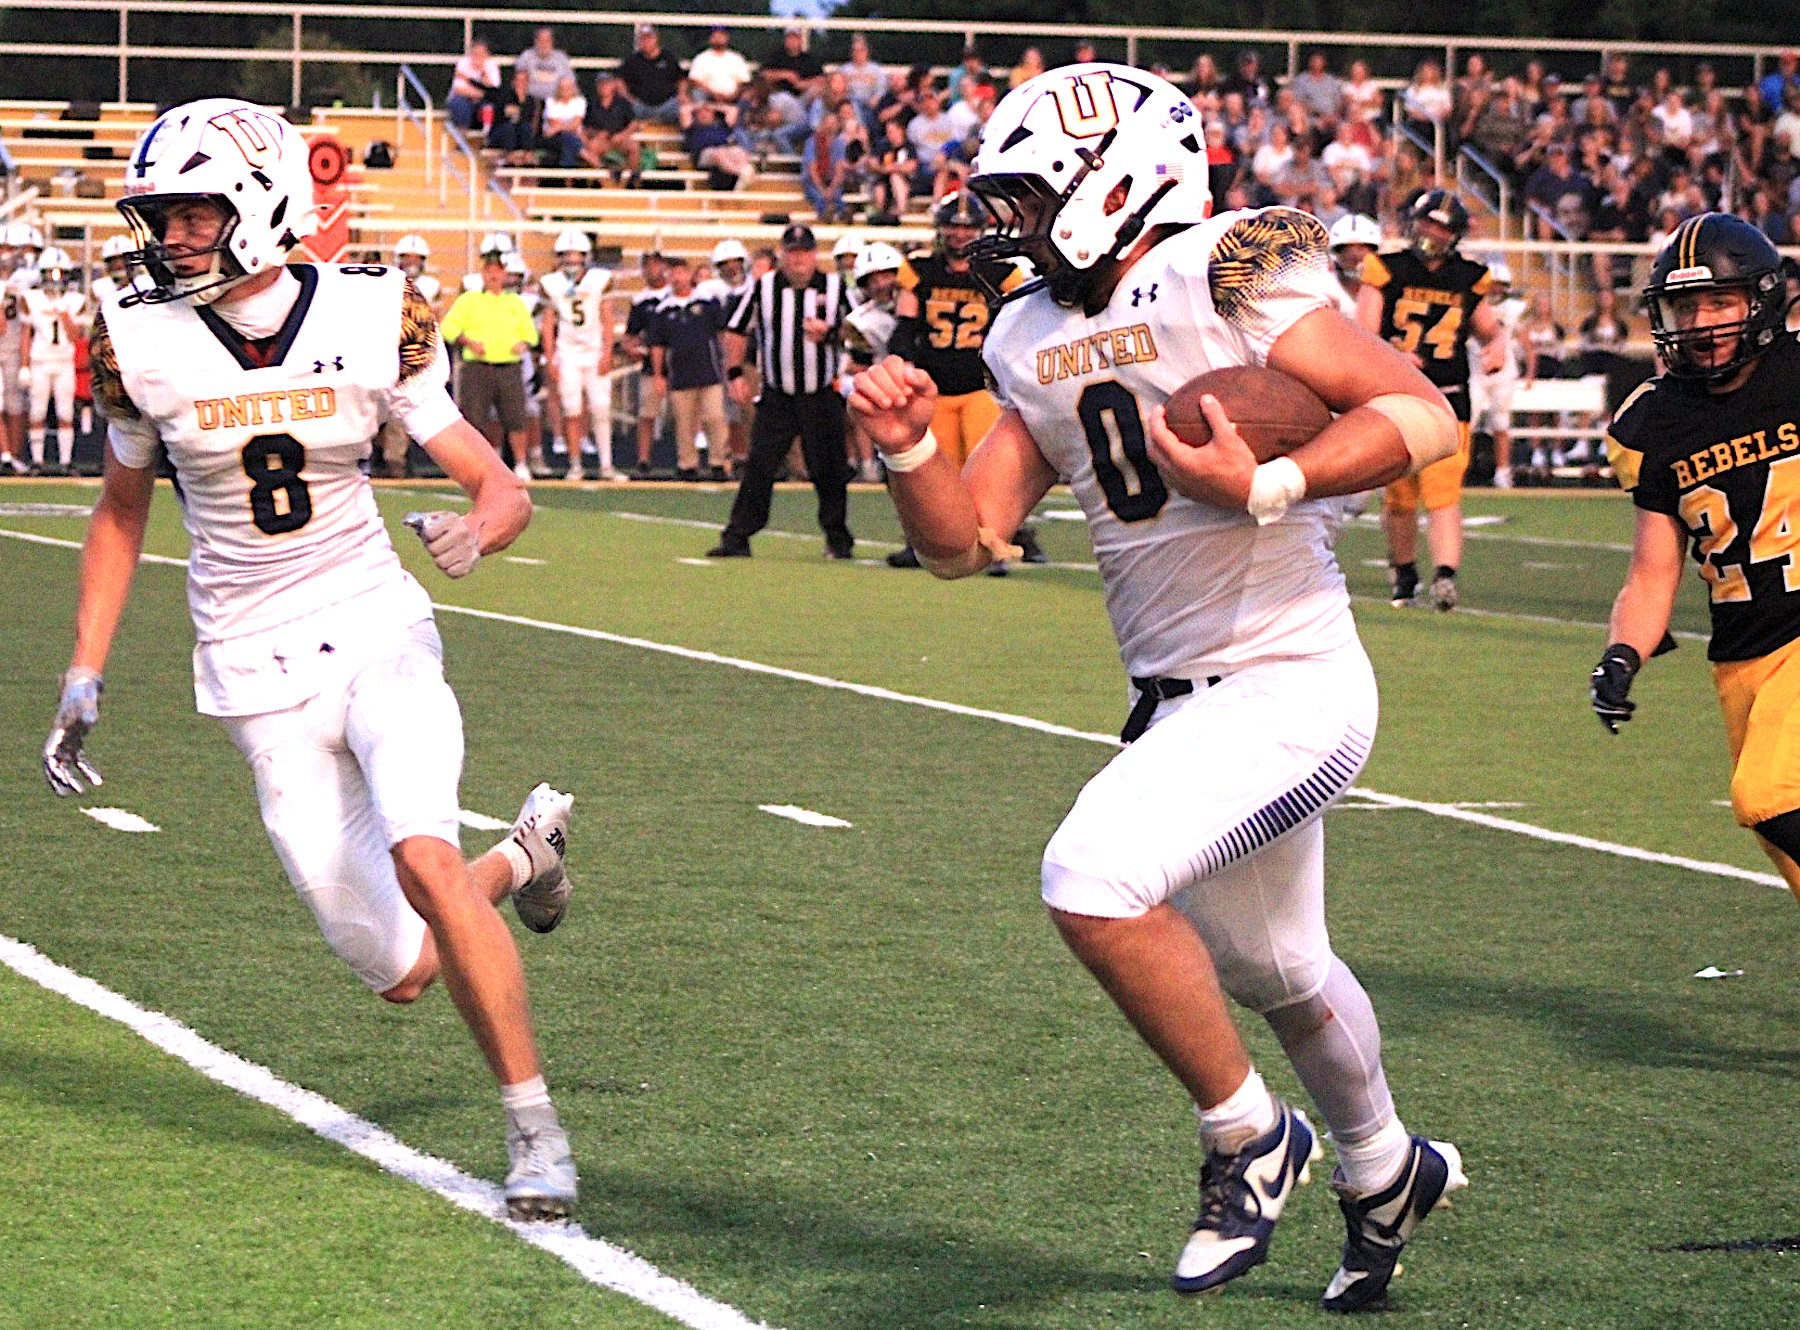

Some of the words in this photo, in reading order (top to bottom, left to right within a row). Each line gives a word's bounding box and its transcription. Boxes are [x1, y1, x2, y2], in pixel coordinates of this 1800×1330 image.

[1048, 70, 1120, 139] U
[52, 320, 60, 344] 1
[571, 299, 586, 327] 5
[925, 299, 990, 349] 52
[1389, 298, 1463, 359] 54
[1036, 322, 1158, 385] UNITED
[194, 386, 337, 430] UNITED
[1076, 378, 1169, 524] 0
[1670, 422, 1800, 489] REBELS
[241, 431, 313, 537] 8
[1678, 454, 1800, 604] 24
